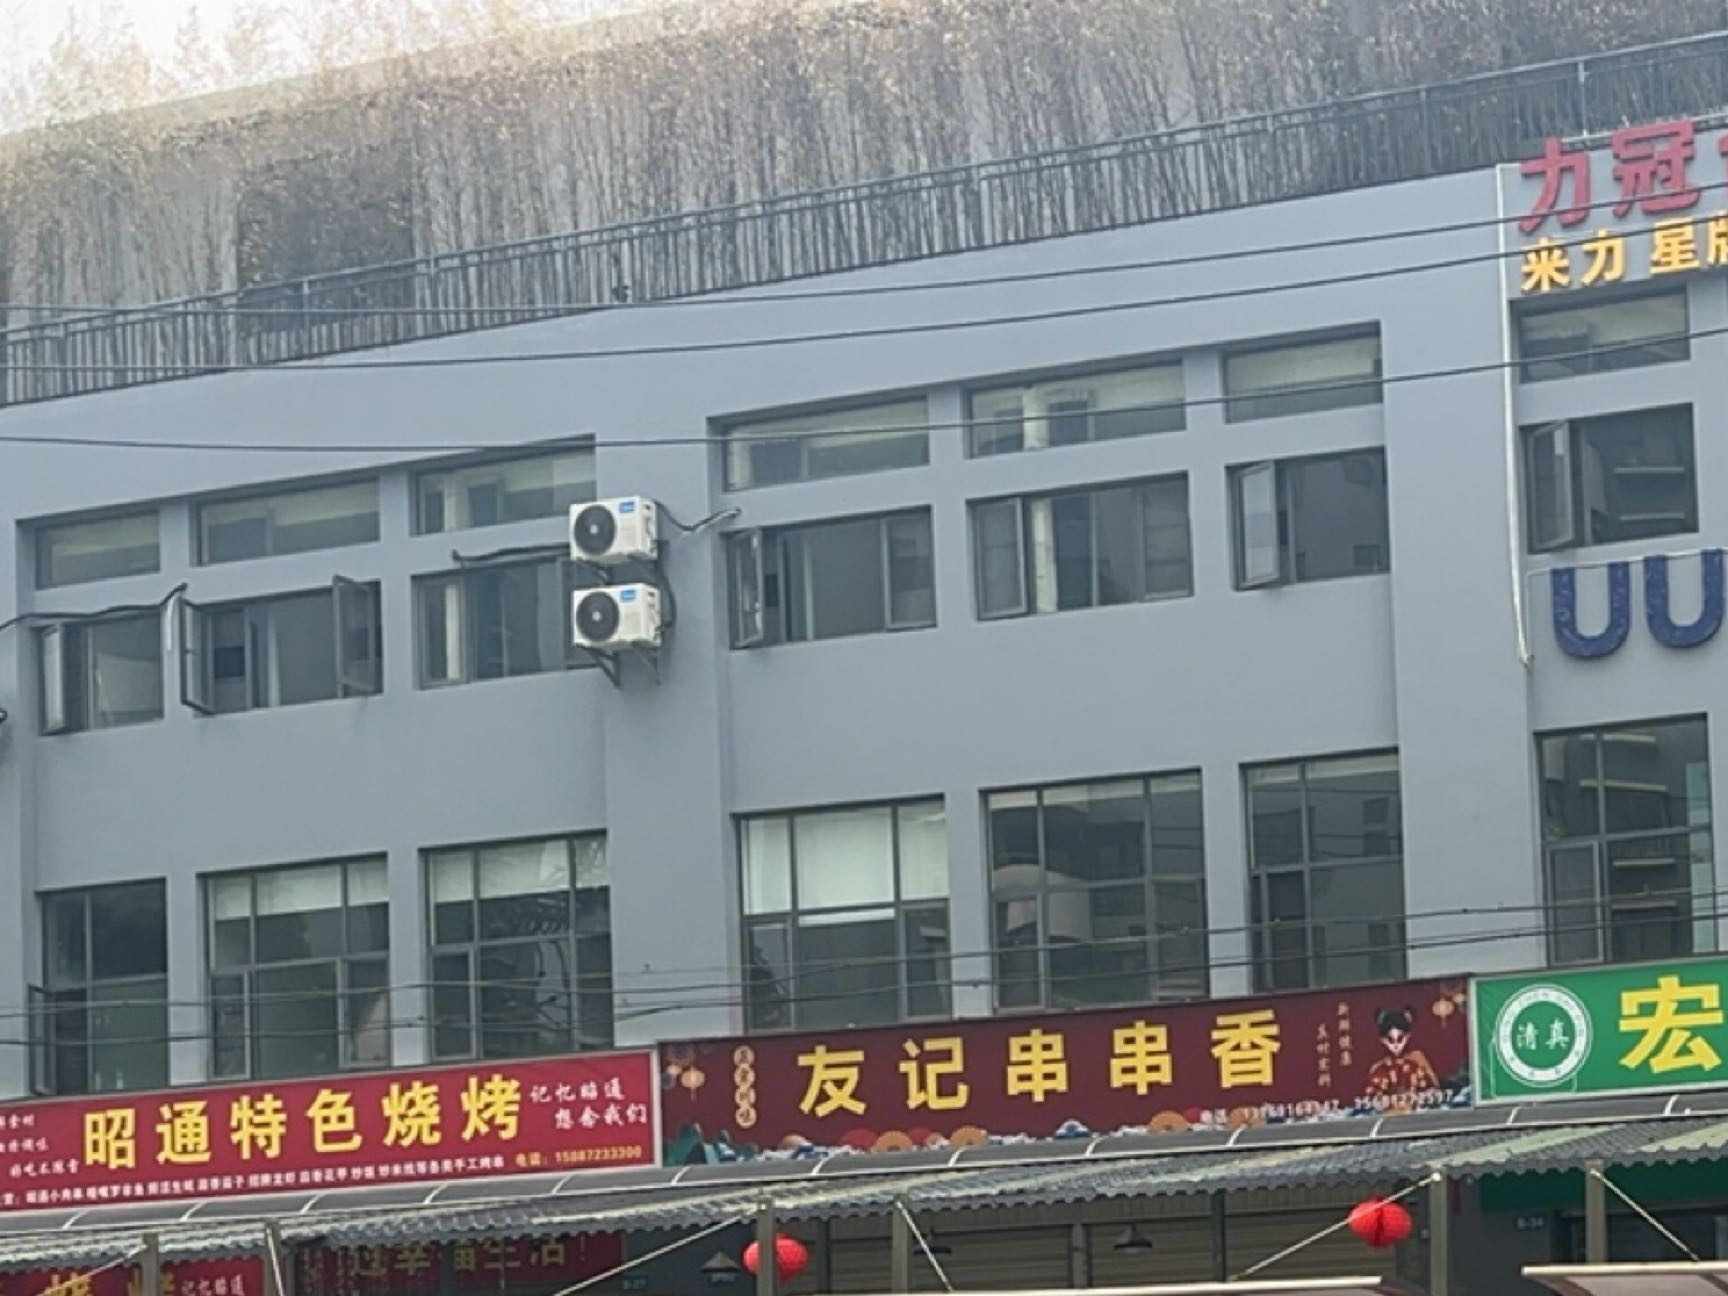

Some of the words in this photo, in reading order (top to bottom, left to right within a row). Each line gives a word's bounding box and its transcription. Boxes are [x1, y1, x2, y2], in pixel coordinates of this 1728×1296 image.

[797, 1009, 1281, 1119] 友记串串香
[1517, 1017, 1570, 1051] 清真
[84, 1074, 521, 1169] 昭通特色烧烤
[555, 1103, 647, 1130] 想念我们
